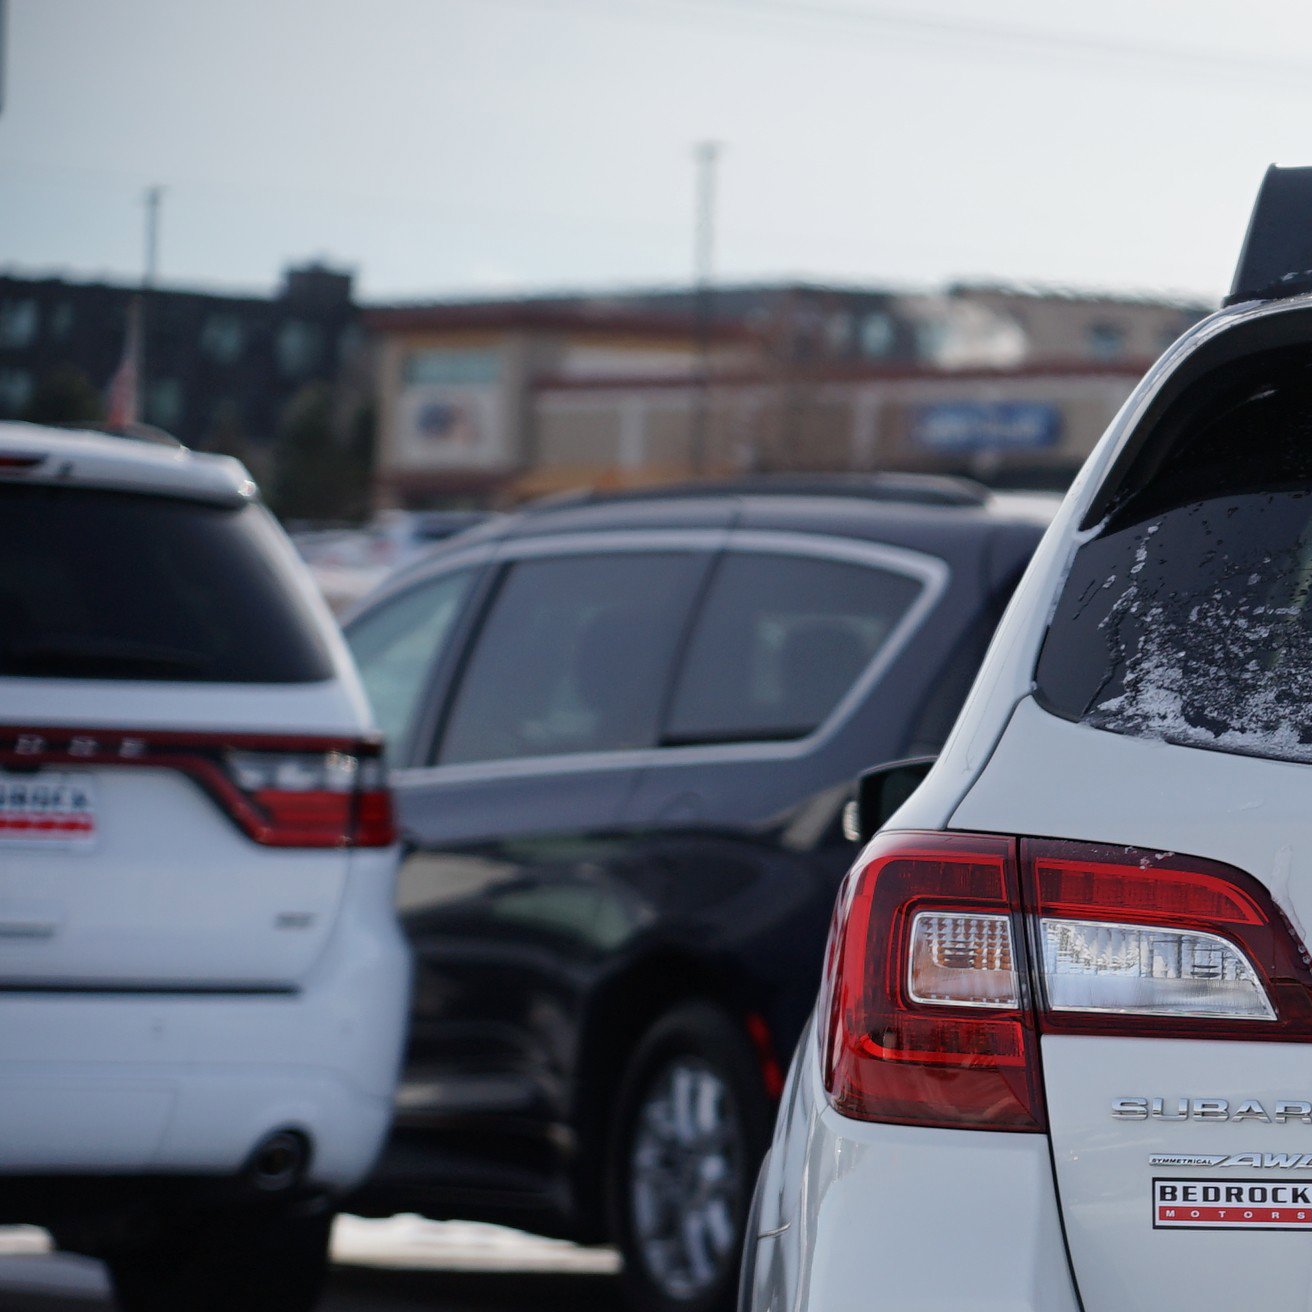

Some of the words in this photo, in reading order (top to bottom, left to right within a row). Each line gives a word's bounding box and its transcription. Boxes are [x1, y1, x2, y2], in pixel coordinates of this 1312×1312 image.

[1151, 1157, 1213, 1166] SYMMETRICAL
[1158, 1185, 1312, 1204] BEDROCK
[1165, 1209, 1306, 1220] MOTORS
